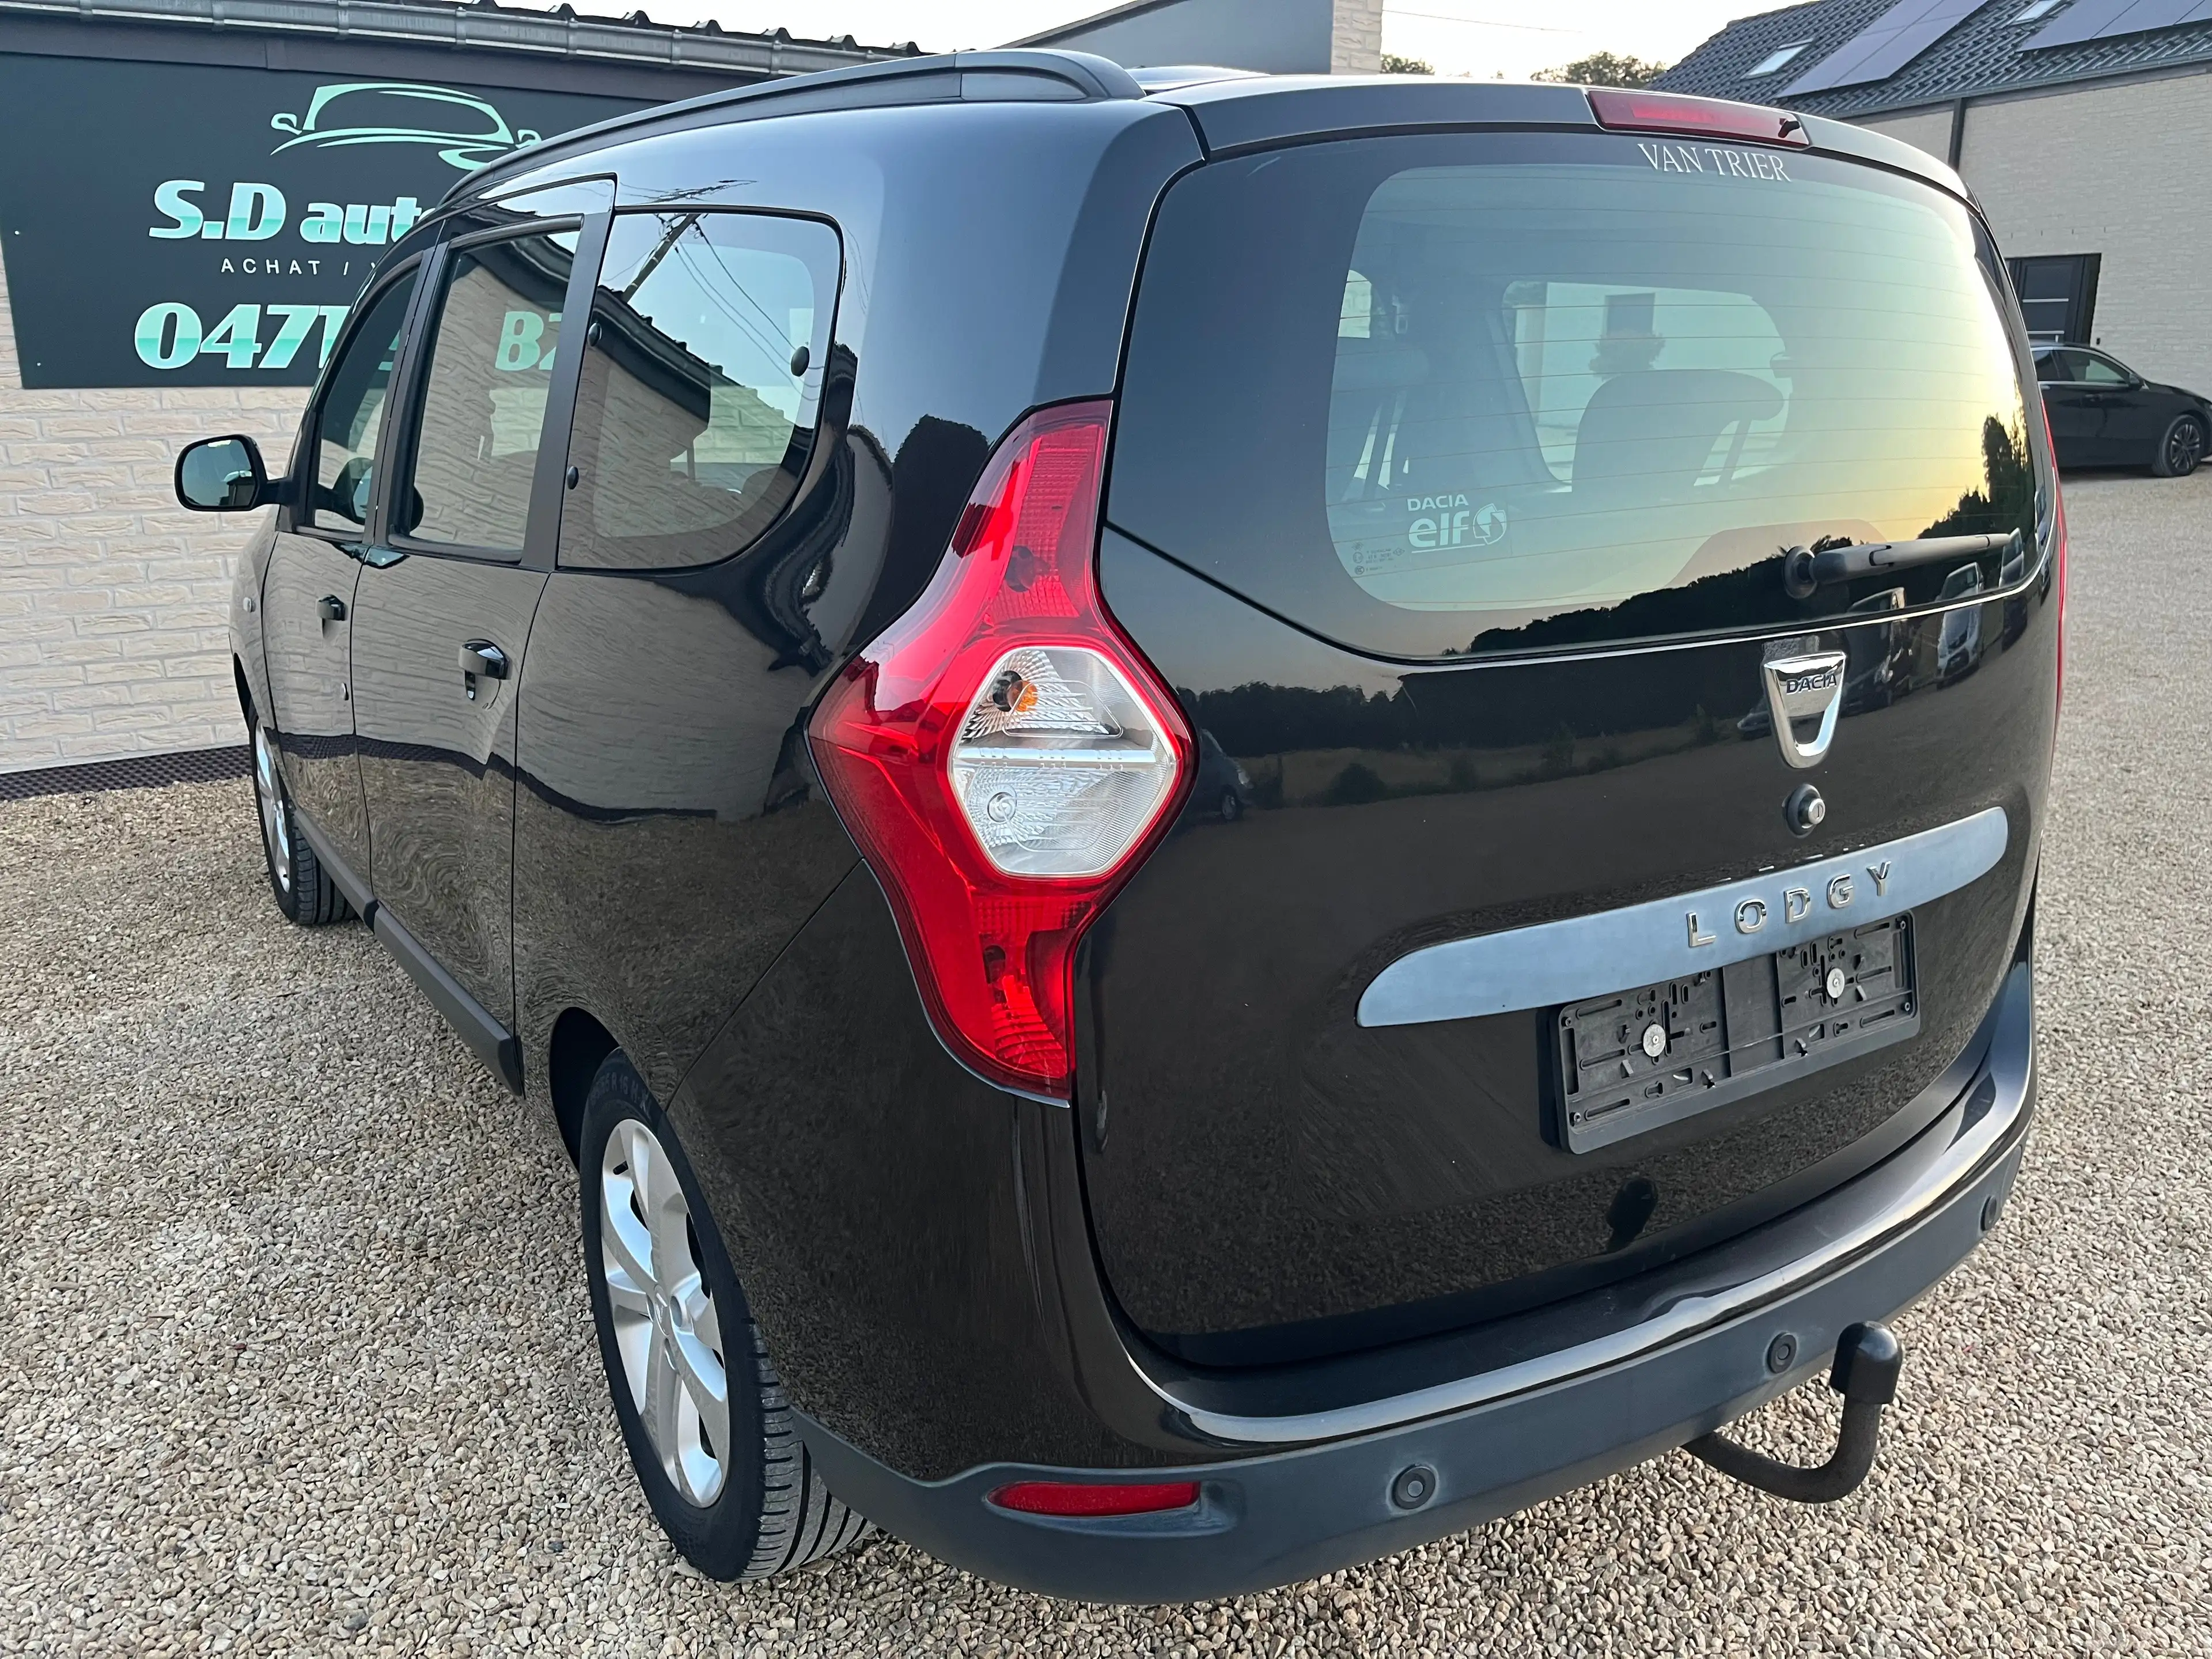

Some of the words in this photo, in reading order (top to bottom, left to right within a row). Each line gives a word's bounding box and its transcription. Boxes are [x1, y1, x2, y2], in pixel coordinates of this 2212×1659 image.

[1637, 143, 1703, 173] VAN
[1705, 149, 1791, 182] TRIER
[149, 180, 286, 240] S.D
[300, 196, 436, 244] aut
[221, 257, 320, 275] ACHAT
[1407, 494, 1468, 511] DACIA
[1408, 512, 1469, 548] elf
[1786, 673, 1837, 695] DACIA
[1687, 860, 1892, 947] LODGY
